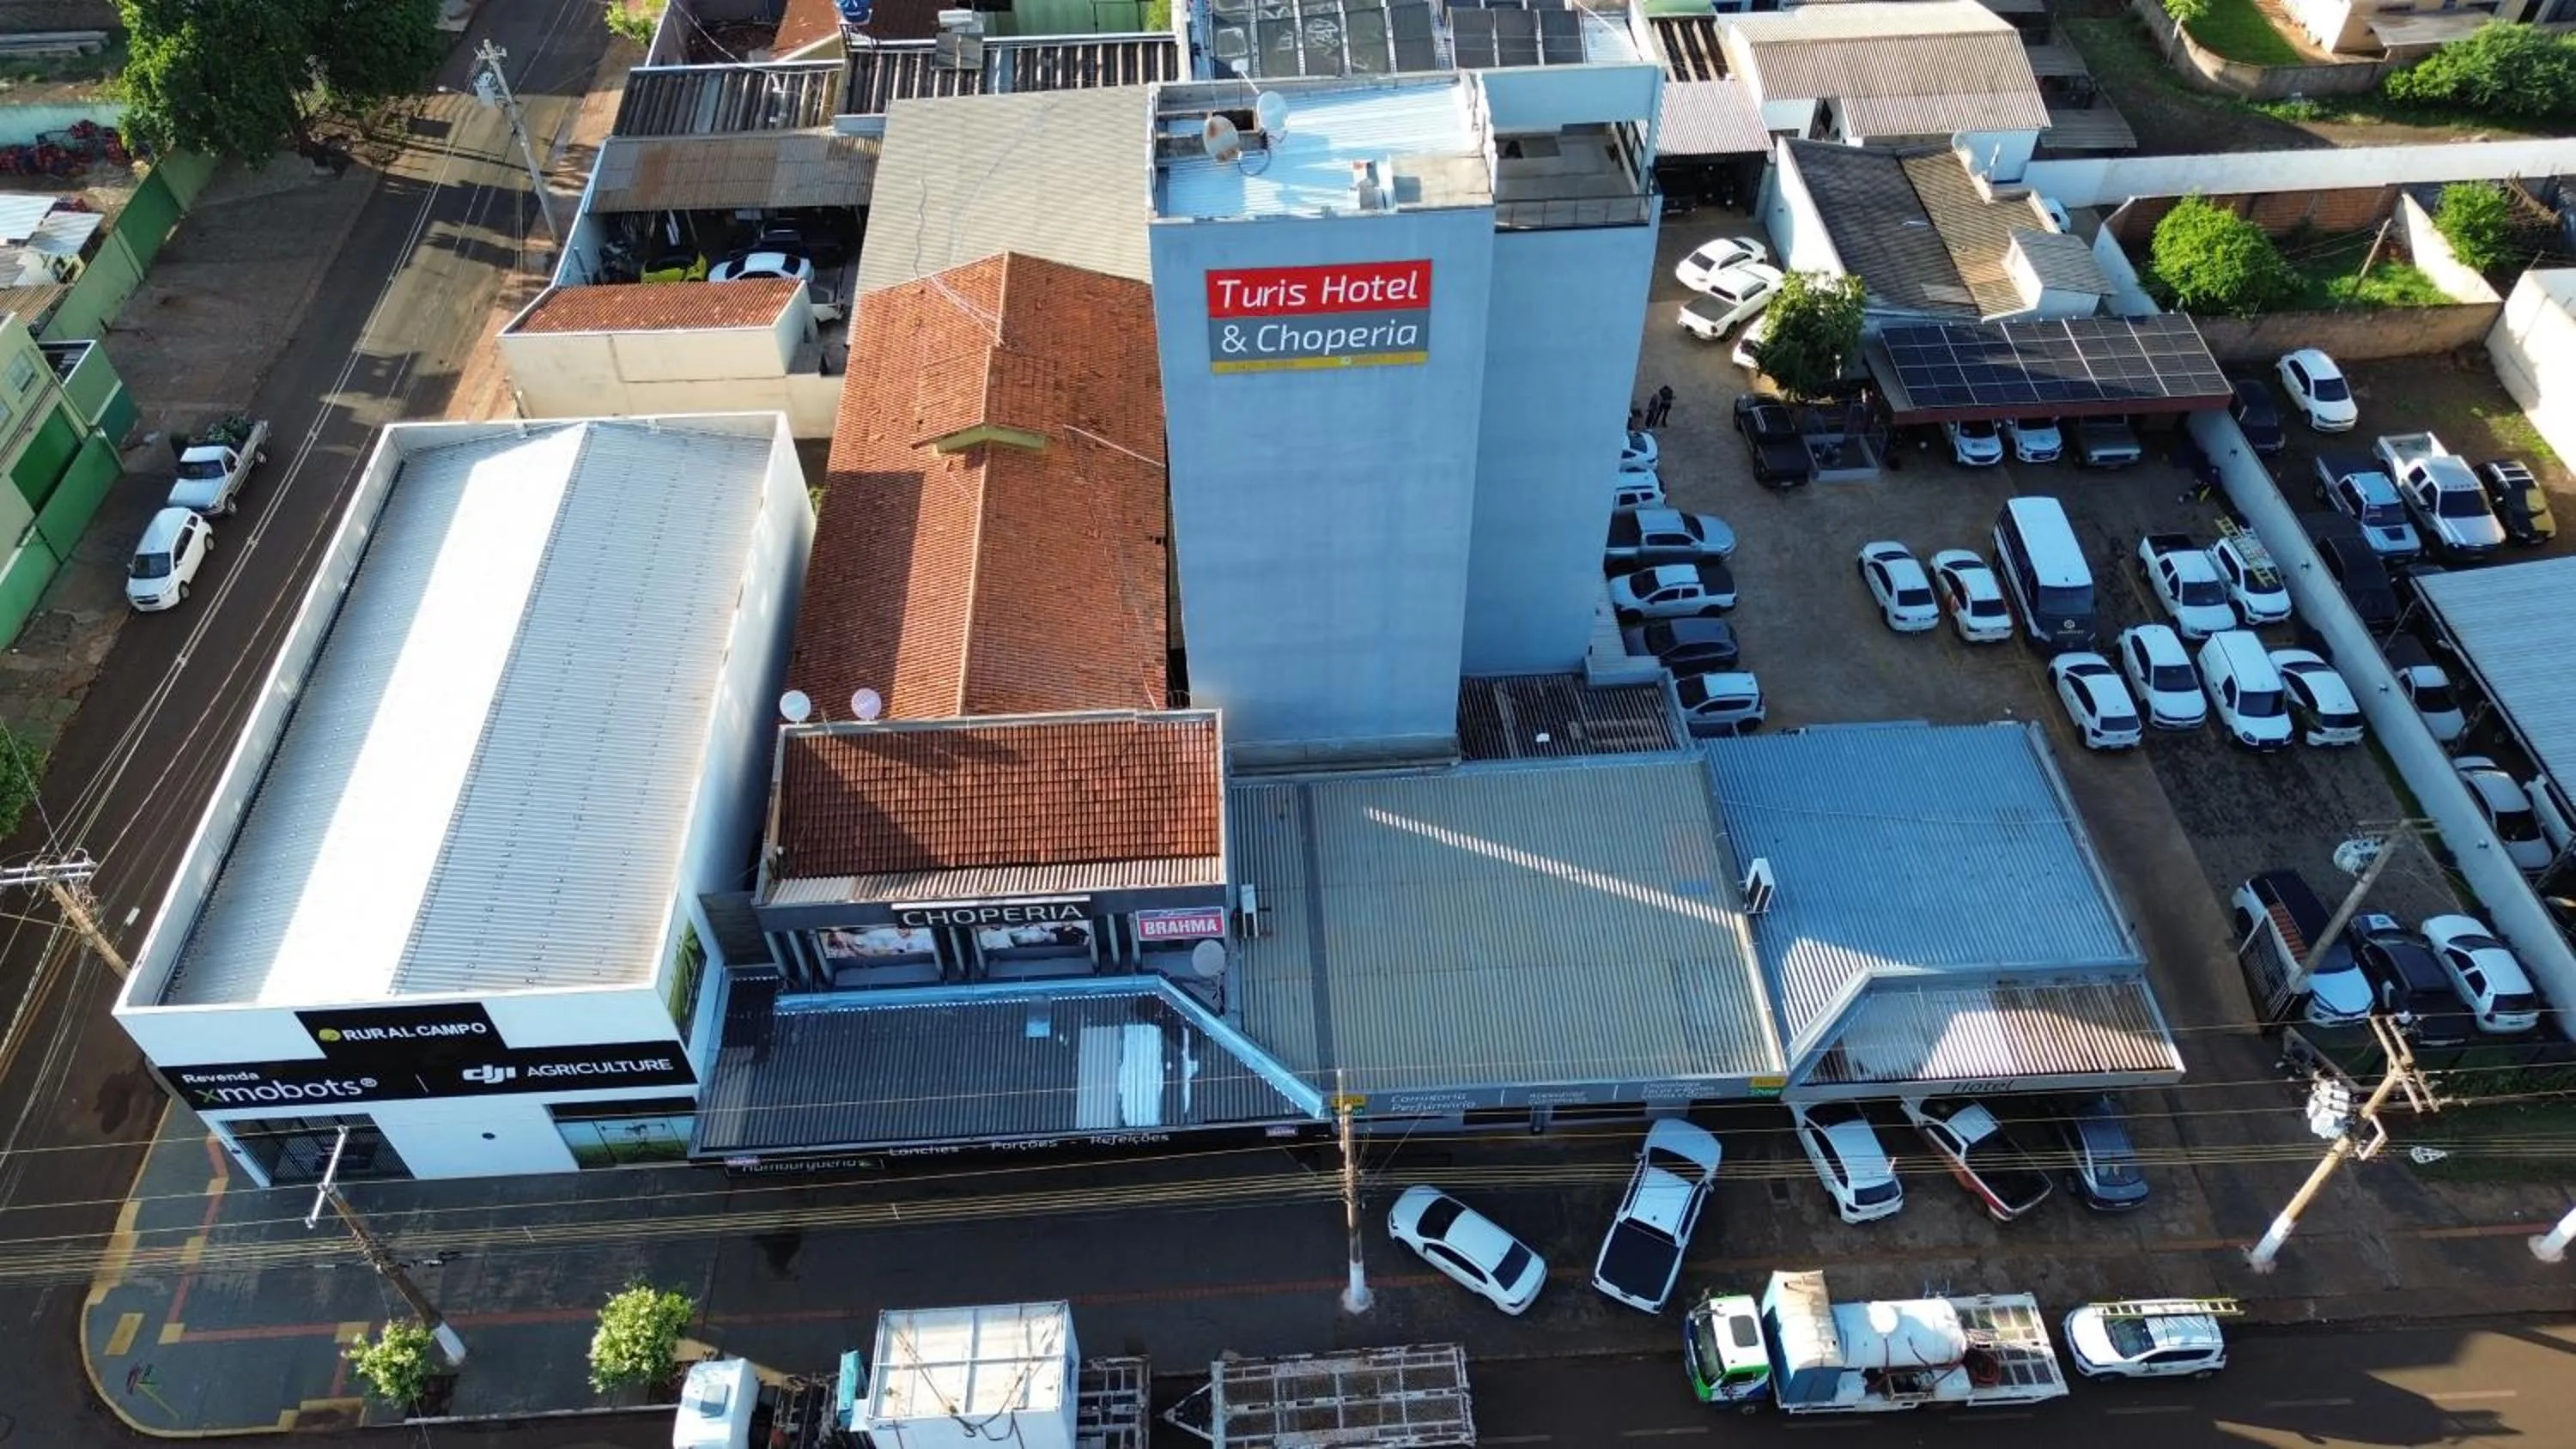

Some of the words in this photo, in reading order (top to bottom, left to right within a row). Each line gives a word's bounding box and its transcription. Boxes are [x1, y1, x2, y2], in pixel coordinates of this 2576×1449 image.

[1217, 279, 1307, 309] Turis
[1321, 270, 1418, 304] Hotel
[1221, 324, 1248, 354] &
[1256, 318, 1418, 355] Choperia
[902, 904, 1084, 927] CHOPERIA
[1145, 919, 1218, 935] BRAHMA
[342, 1028, 415, 1041] RURAL
[416, 1022, 487, 1037] CAMPO
[526, 1058, 674, 1077] AGRICULTURE
[182, 1071, 259, 1084] Revenda
[1951, 1077, 2014, 1093] Hotel
